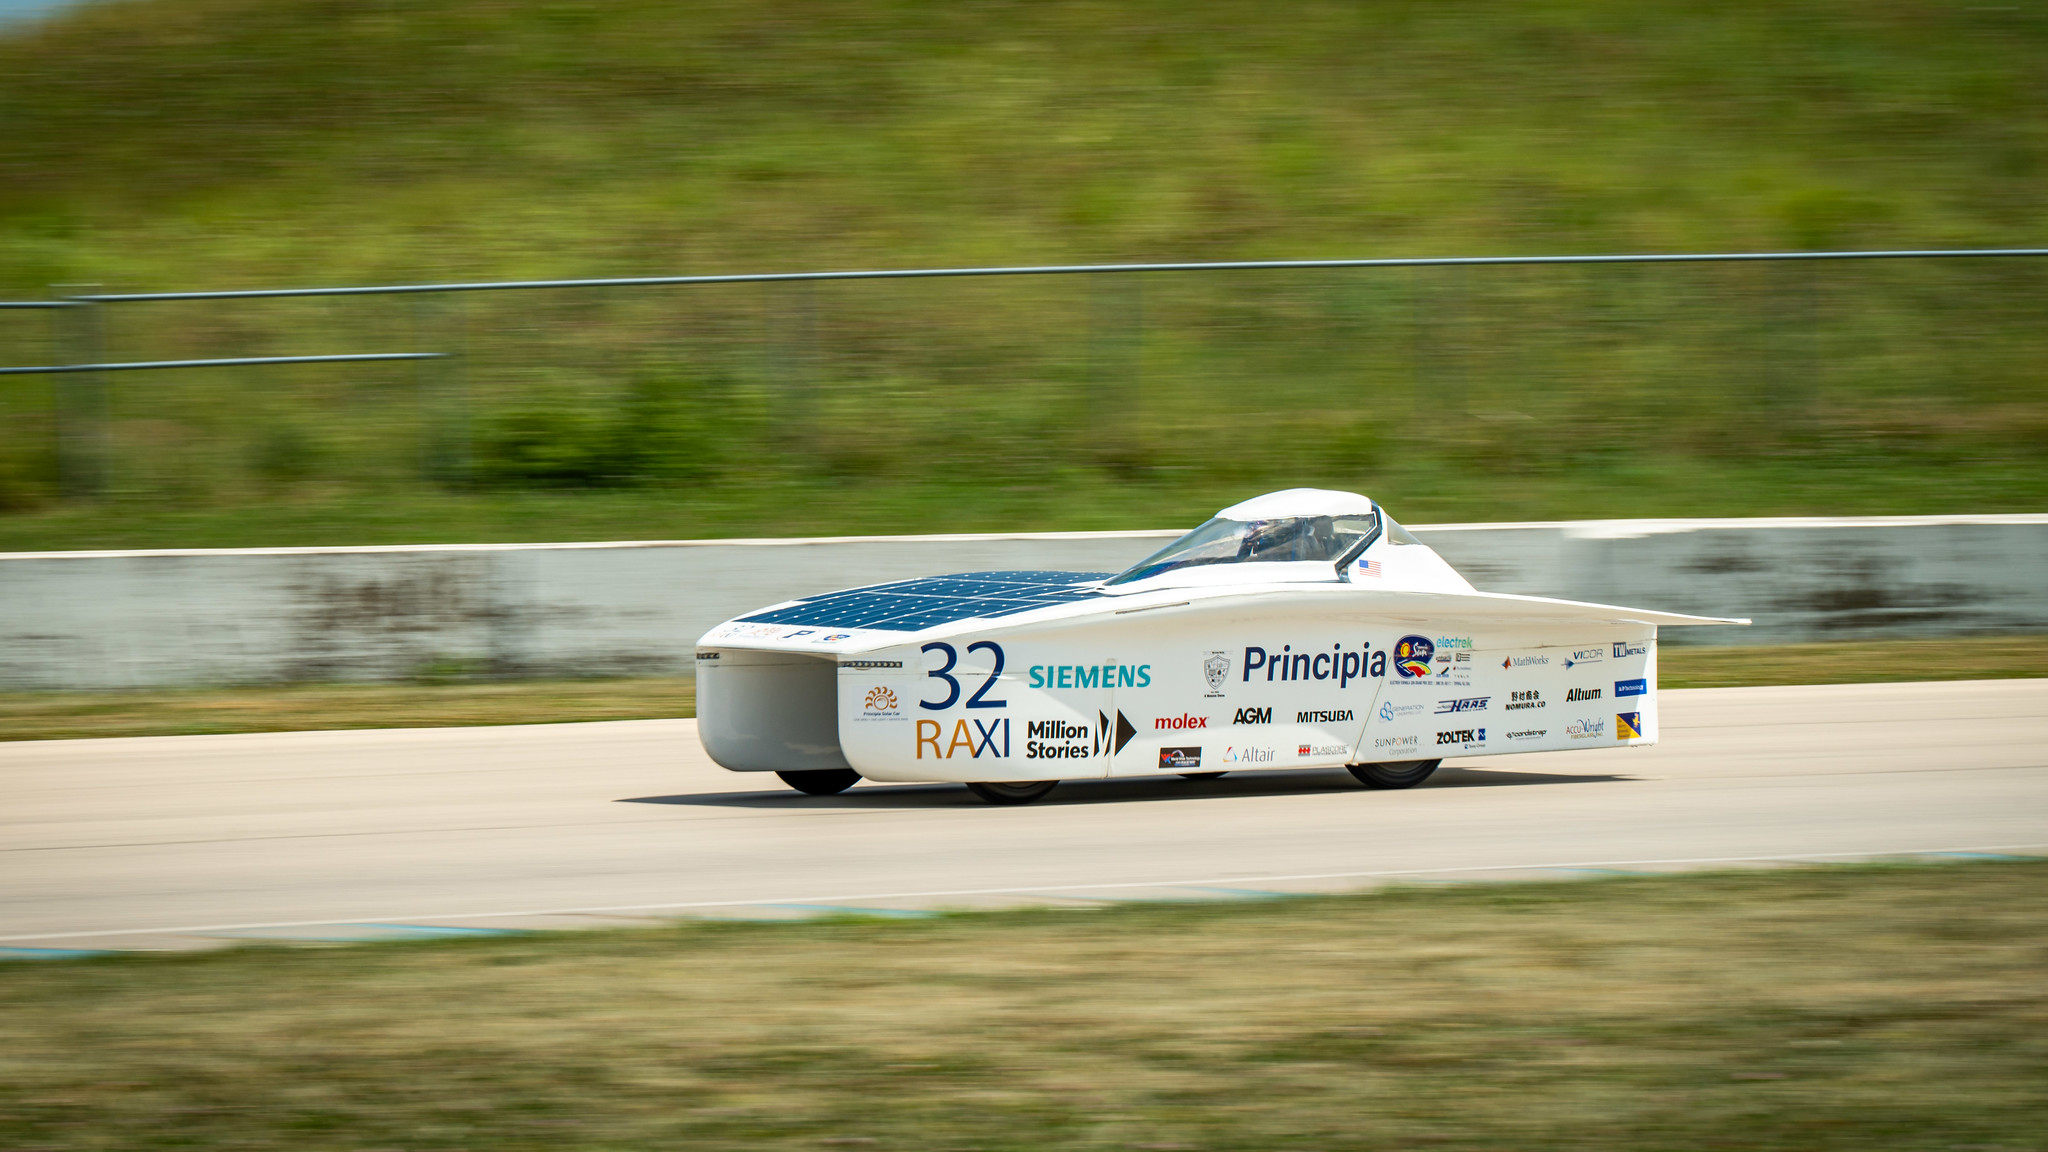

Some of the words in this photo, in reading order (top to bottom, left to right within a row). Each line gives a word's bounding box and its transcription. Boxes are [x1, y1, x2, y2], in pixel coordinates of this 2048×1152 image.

[1436, 636, 1472, 649] electrek
[1573, 649, 1604, 660] VICOR
[1627, 647, 1646, 656] METALS
[1243, 641, 1387, 688] Principia
[1513, 655, 1549, 667] MathWorks
[919, 641, 1007, 710] 32
[1029, 664, 1151, 689] SIEMENS
[1566, 688, 1601, 702] Altium
[1450, 699, 1488, 712] HAAS
[1155, 713, 1207, 729] molex
[1233, 707, 1272, 724] AGM
[1297, 710, 1354, 723] MITSUBA
[1027, 721, 1088, 739] Million
[1436, 729, 1475, 744] ZOLTEK
[916, 718, 1010, 759] RAXI
[1375, 736, 1418, 747] SUNPOWER
[1026, 741, 1089, 759] Stories
[1241, 747, 1275, 762] Altair
